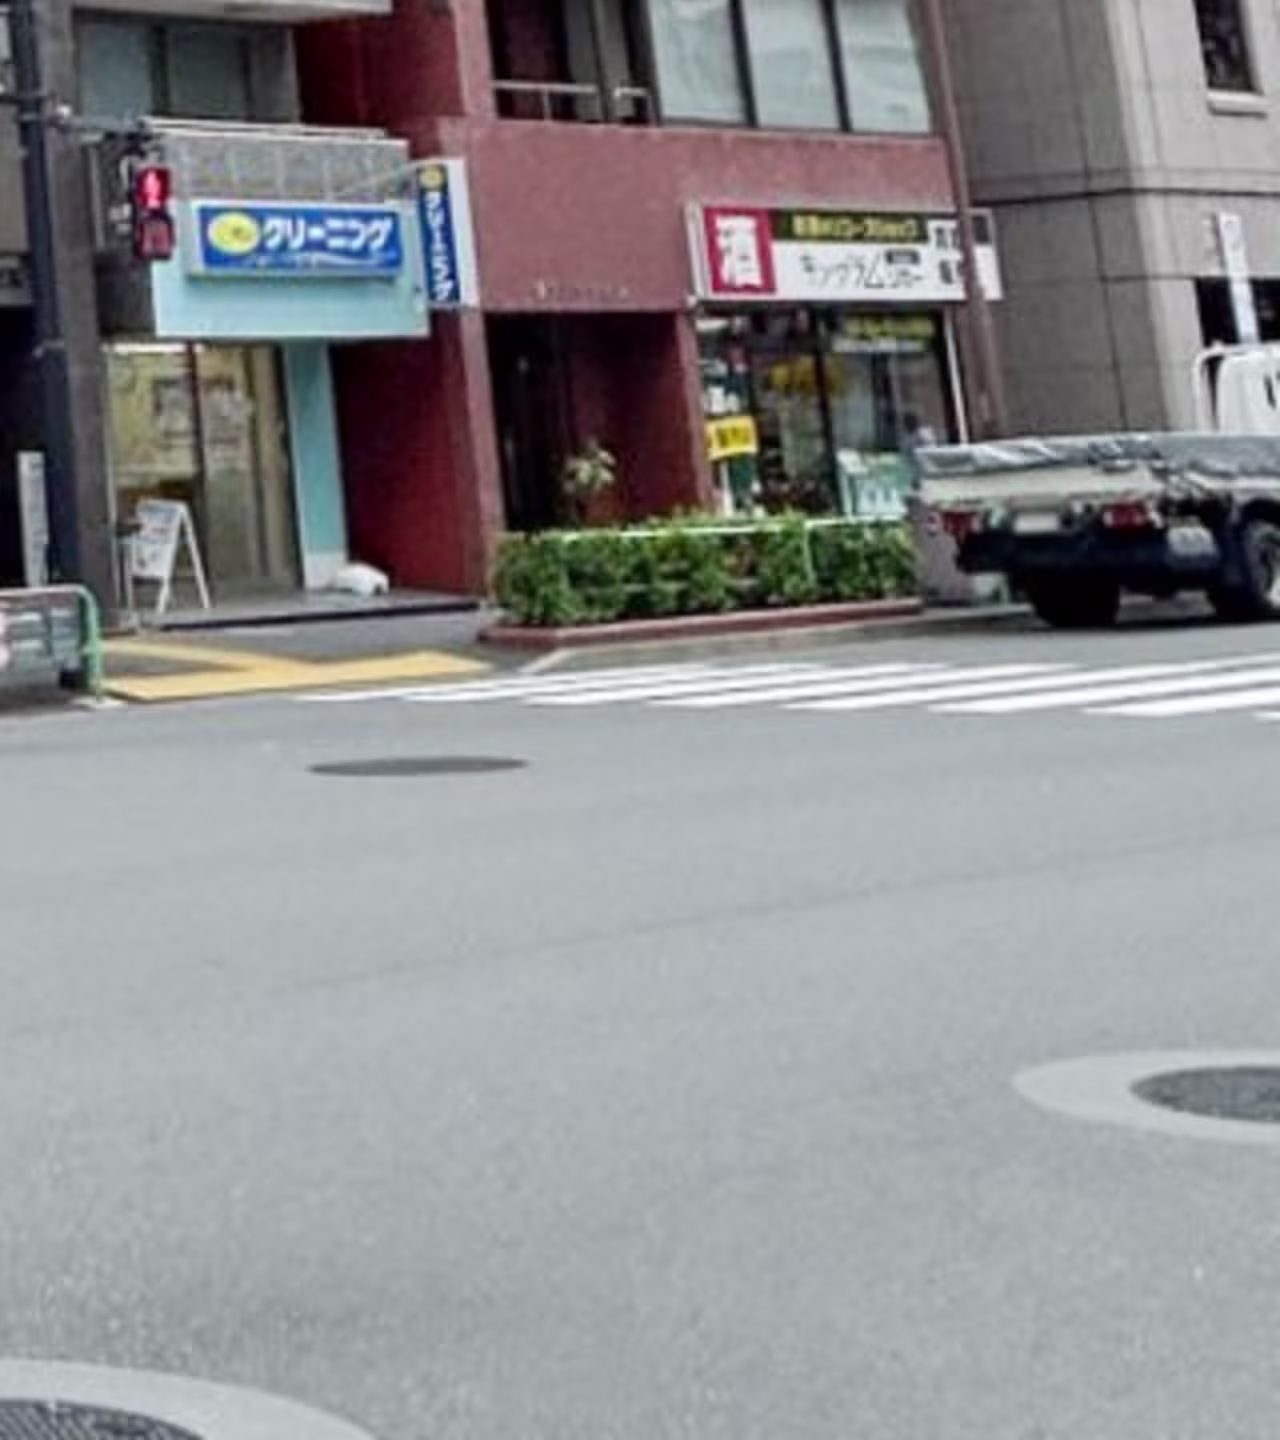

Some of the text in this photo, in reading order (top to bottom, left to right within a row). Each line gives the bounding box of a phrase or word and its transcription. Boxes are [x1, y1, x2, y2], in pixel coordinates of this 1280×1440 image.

[264, 216, 392, 250] クリーニング
[715, 215, 763, 287] 酒
